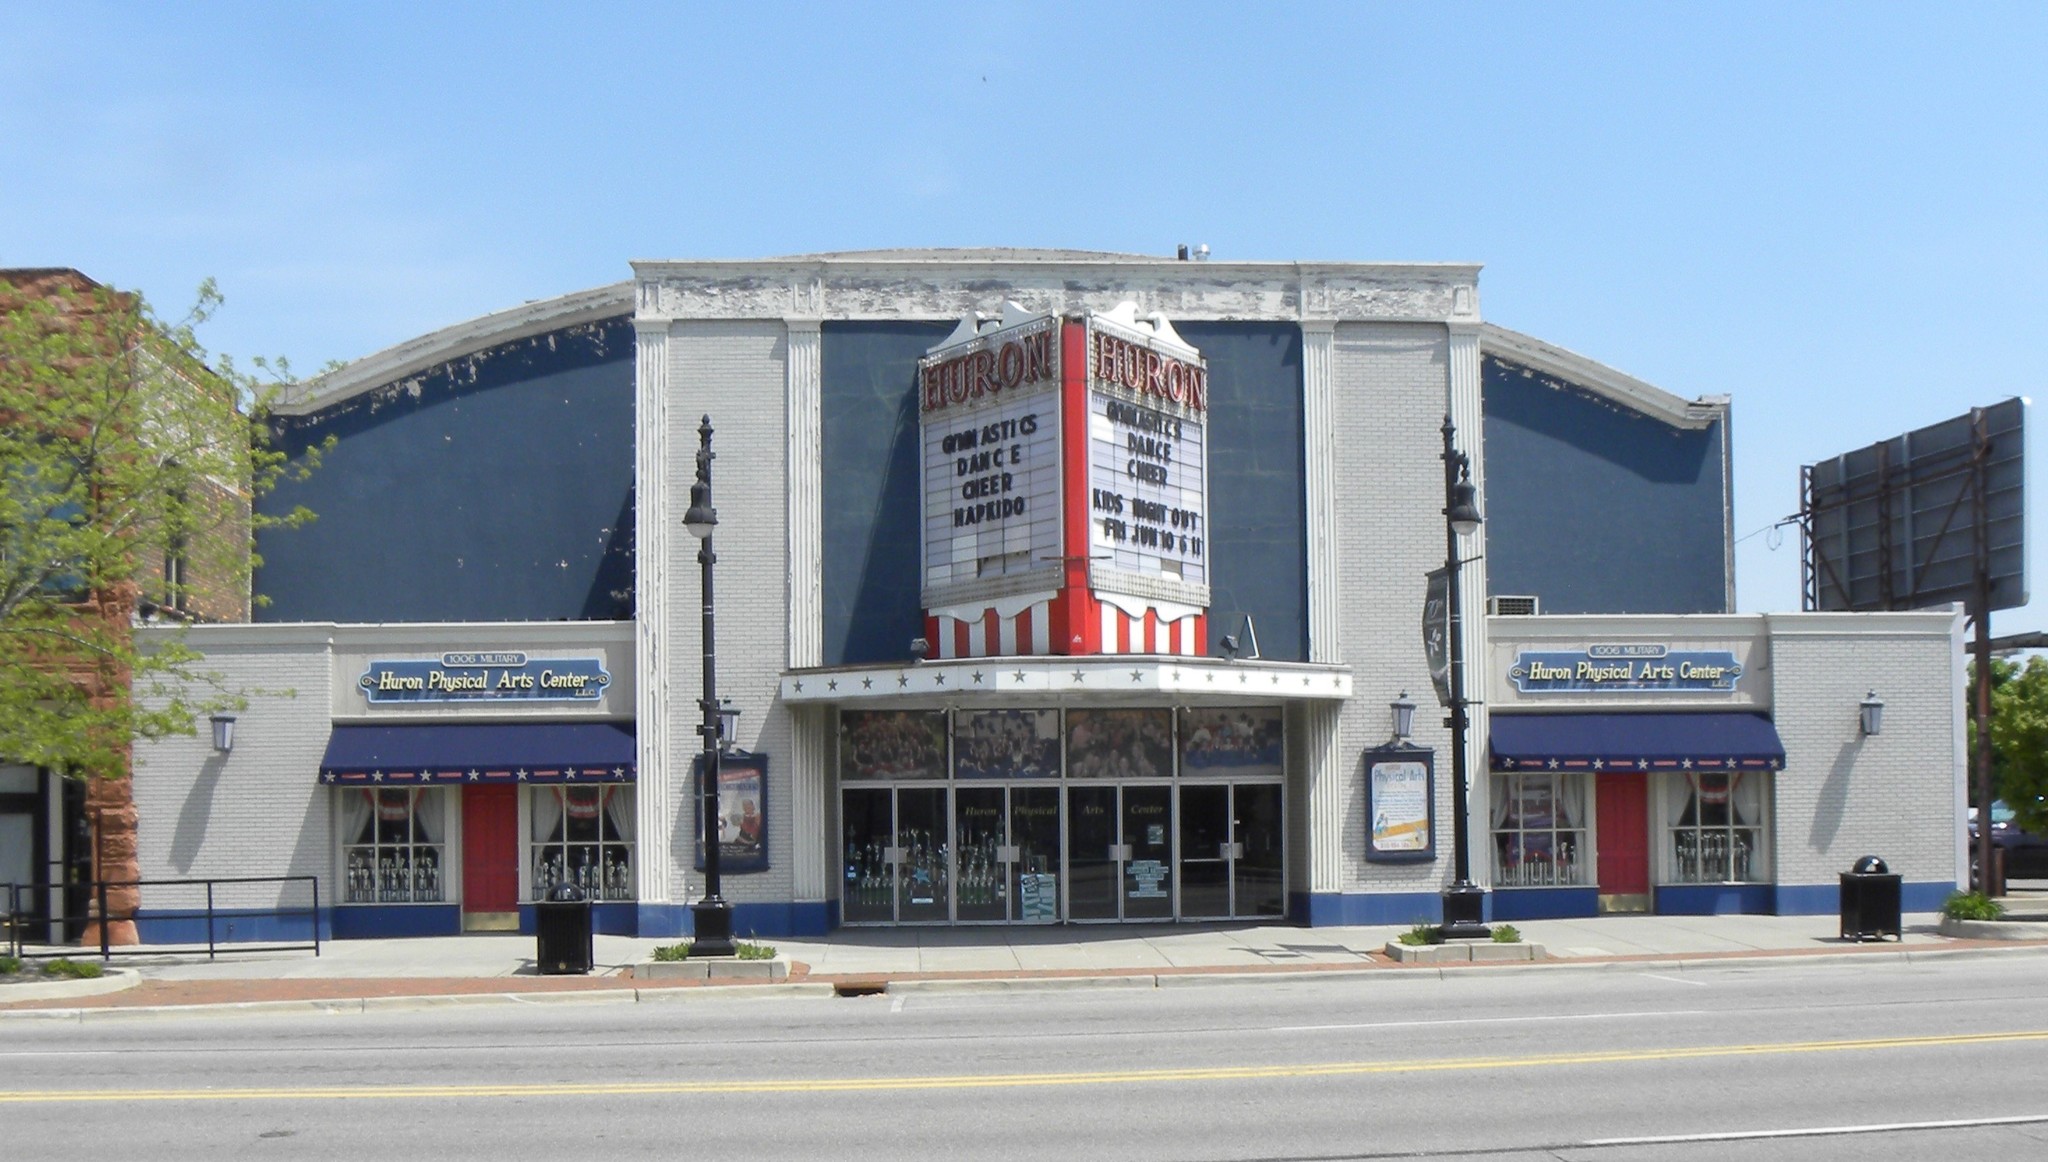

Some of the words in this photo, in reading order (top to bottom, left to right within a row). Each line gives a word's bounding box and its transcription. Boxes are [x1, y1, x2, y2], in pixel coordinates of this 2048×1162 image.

[922, 331, 1053, 411] HURON
[1095, 331, 1206, 411] HURON
[957, 444, 1021, 476] DANCE
[1128, 432, 1171, 463] DANCE
[962, 472, 1012, 499] CHEER
[1127, 459, 1168, 487] CHEER
[954, 496, 1024, 527] HAPKIDO
[1093, 488, 1123, 514] KIDS
[1132, 497, 1167, 524] NIGHT
[1171, 508, 1197, 532] OUT
[1104, 517, 1126, 543] FRI
[1132, 524, 1157, 549] JUN
[1161, 530, 1174, 551] 10
[449, 654, 476, 663] 1006
[481, 654, 519, 663] MILITARY
[1596, 646, 1620, 655] 1006
[1624, 646, 1659, 655] MILITARY
[379, 671, 423, 690] Huron
[428, 670, 489, 692] Physical
[496, 670, 534, 688] Arts
[540, 669, 588, 688] Center
[1529, 662, 1571, 680] Huron
[1576, 661, 1633, 682] Physical
[1639, 662, 1674, 679] Arts
[1680, 661, 1724, 679] Center
[965, 806, 997, 816] Huron
[1014, 805, 1057, 817] Physical
[1082, 805, 1104, 815] Arts
[1131, 804, 1164, 815] Center
